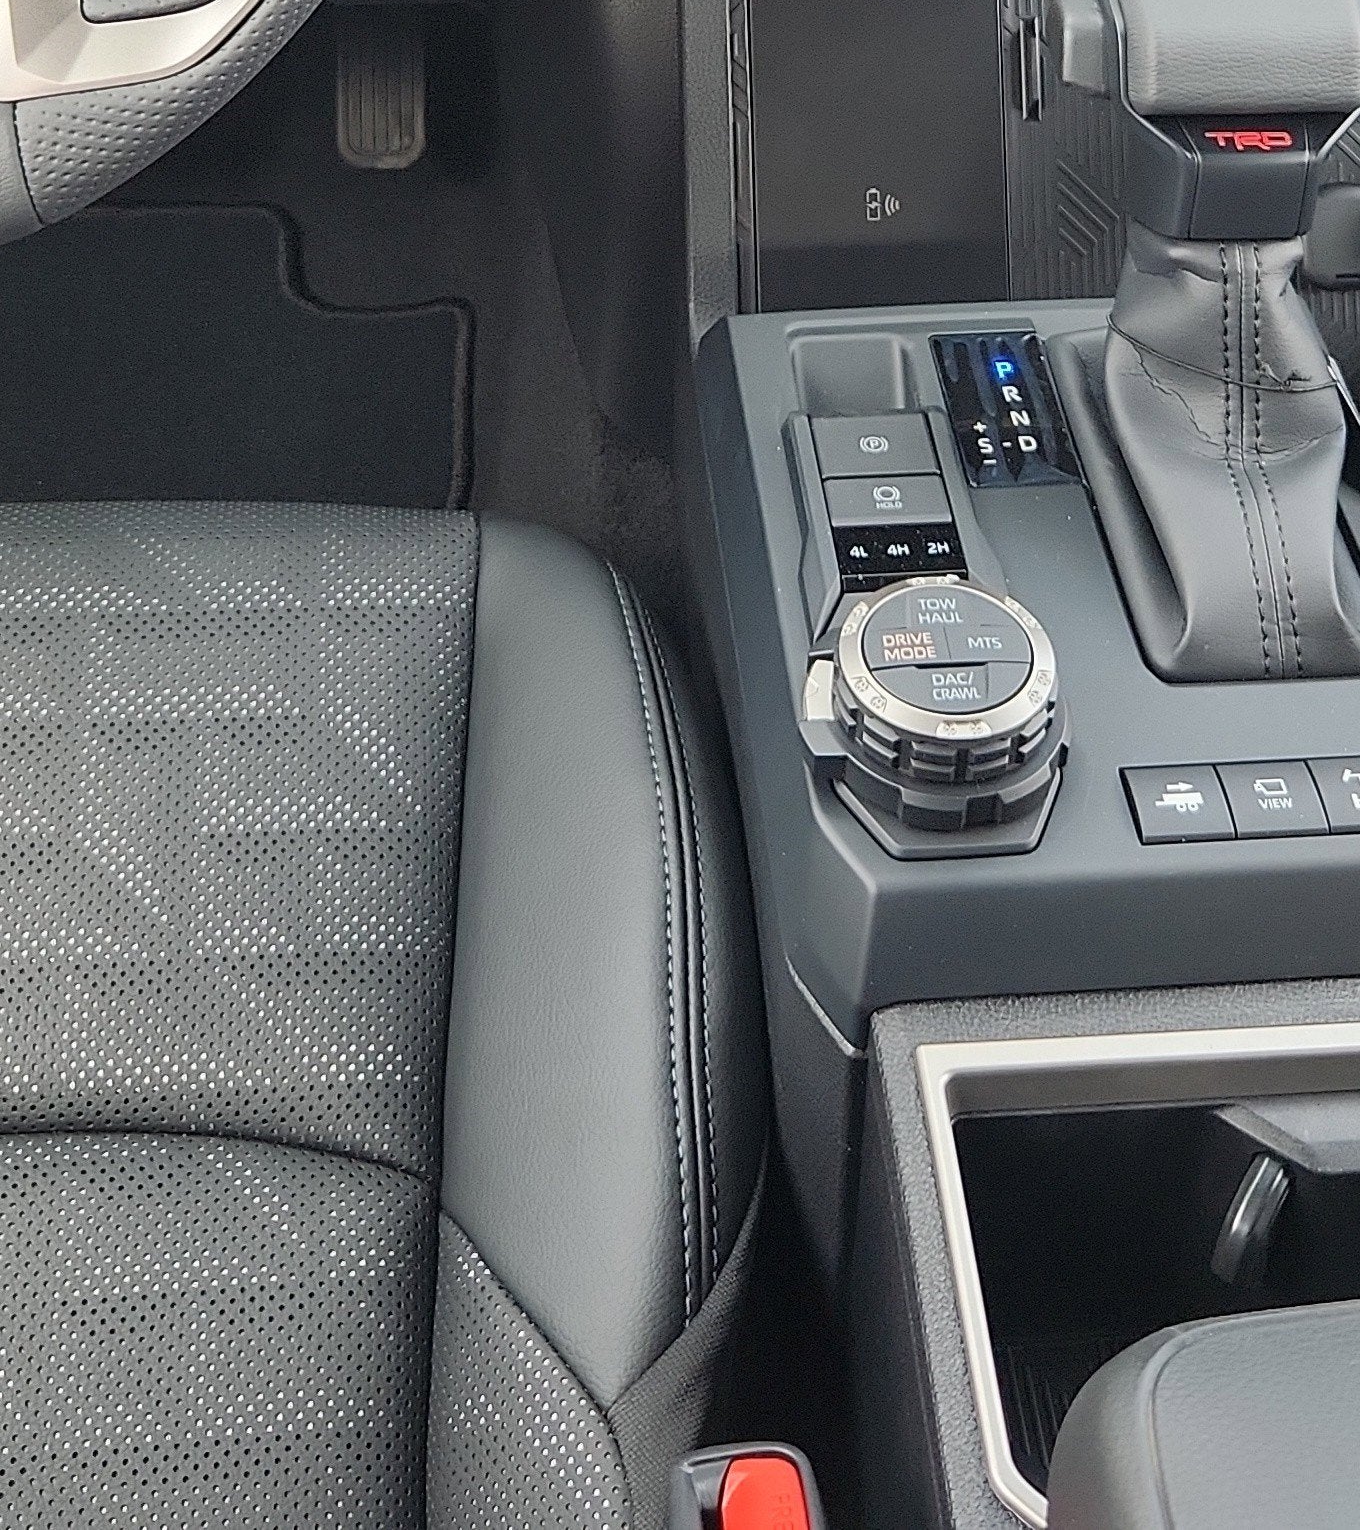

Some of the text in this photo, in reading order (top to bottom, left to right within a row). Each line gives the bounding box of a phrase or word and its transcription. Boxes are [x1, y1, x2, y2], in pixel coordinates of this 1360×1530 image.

[1205, 130, 1293, 152] TRD
[995, 361, 1013, 379] P
[1002, 385, 1022, 402] R
[1010, 410, 1030, 427] N
[1019, 435, 1038, 452] D
[849, 542, 950, 559] 4L 4H 2H
[918, 598, 957, 610] TOW
[918, 612, 964, 624] HAUL
[882, 632, 934, 647] DRIVE
[967, 636, 1003, 650] MTS
[884, 646, 937, 662] MODE
[931, 672, 975, 688] DAC/
[932, 686, 981, 700] CRAWL
[1258, 797, 1293, 810] VIEW
